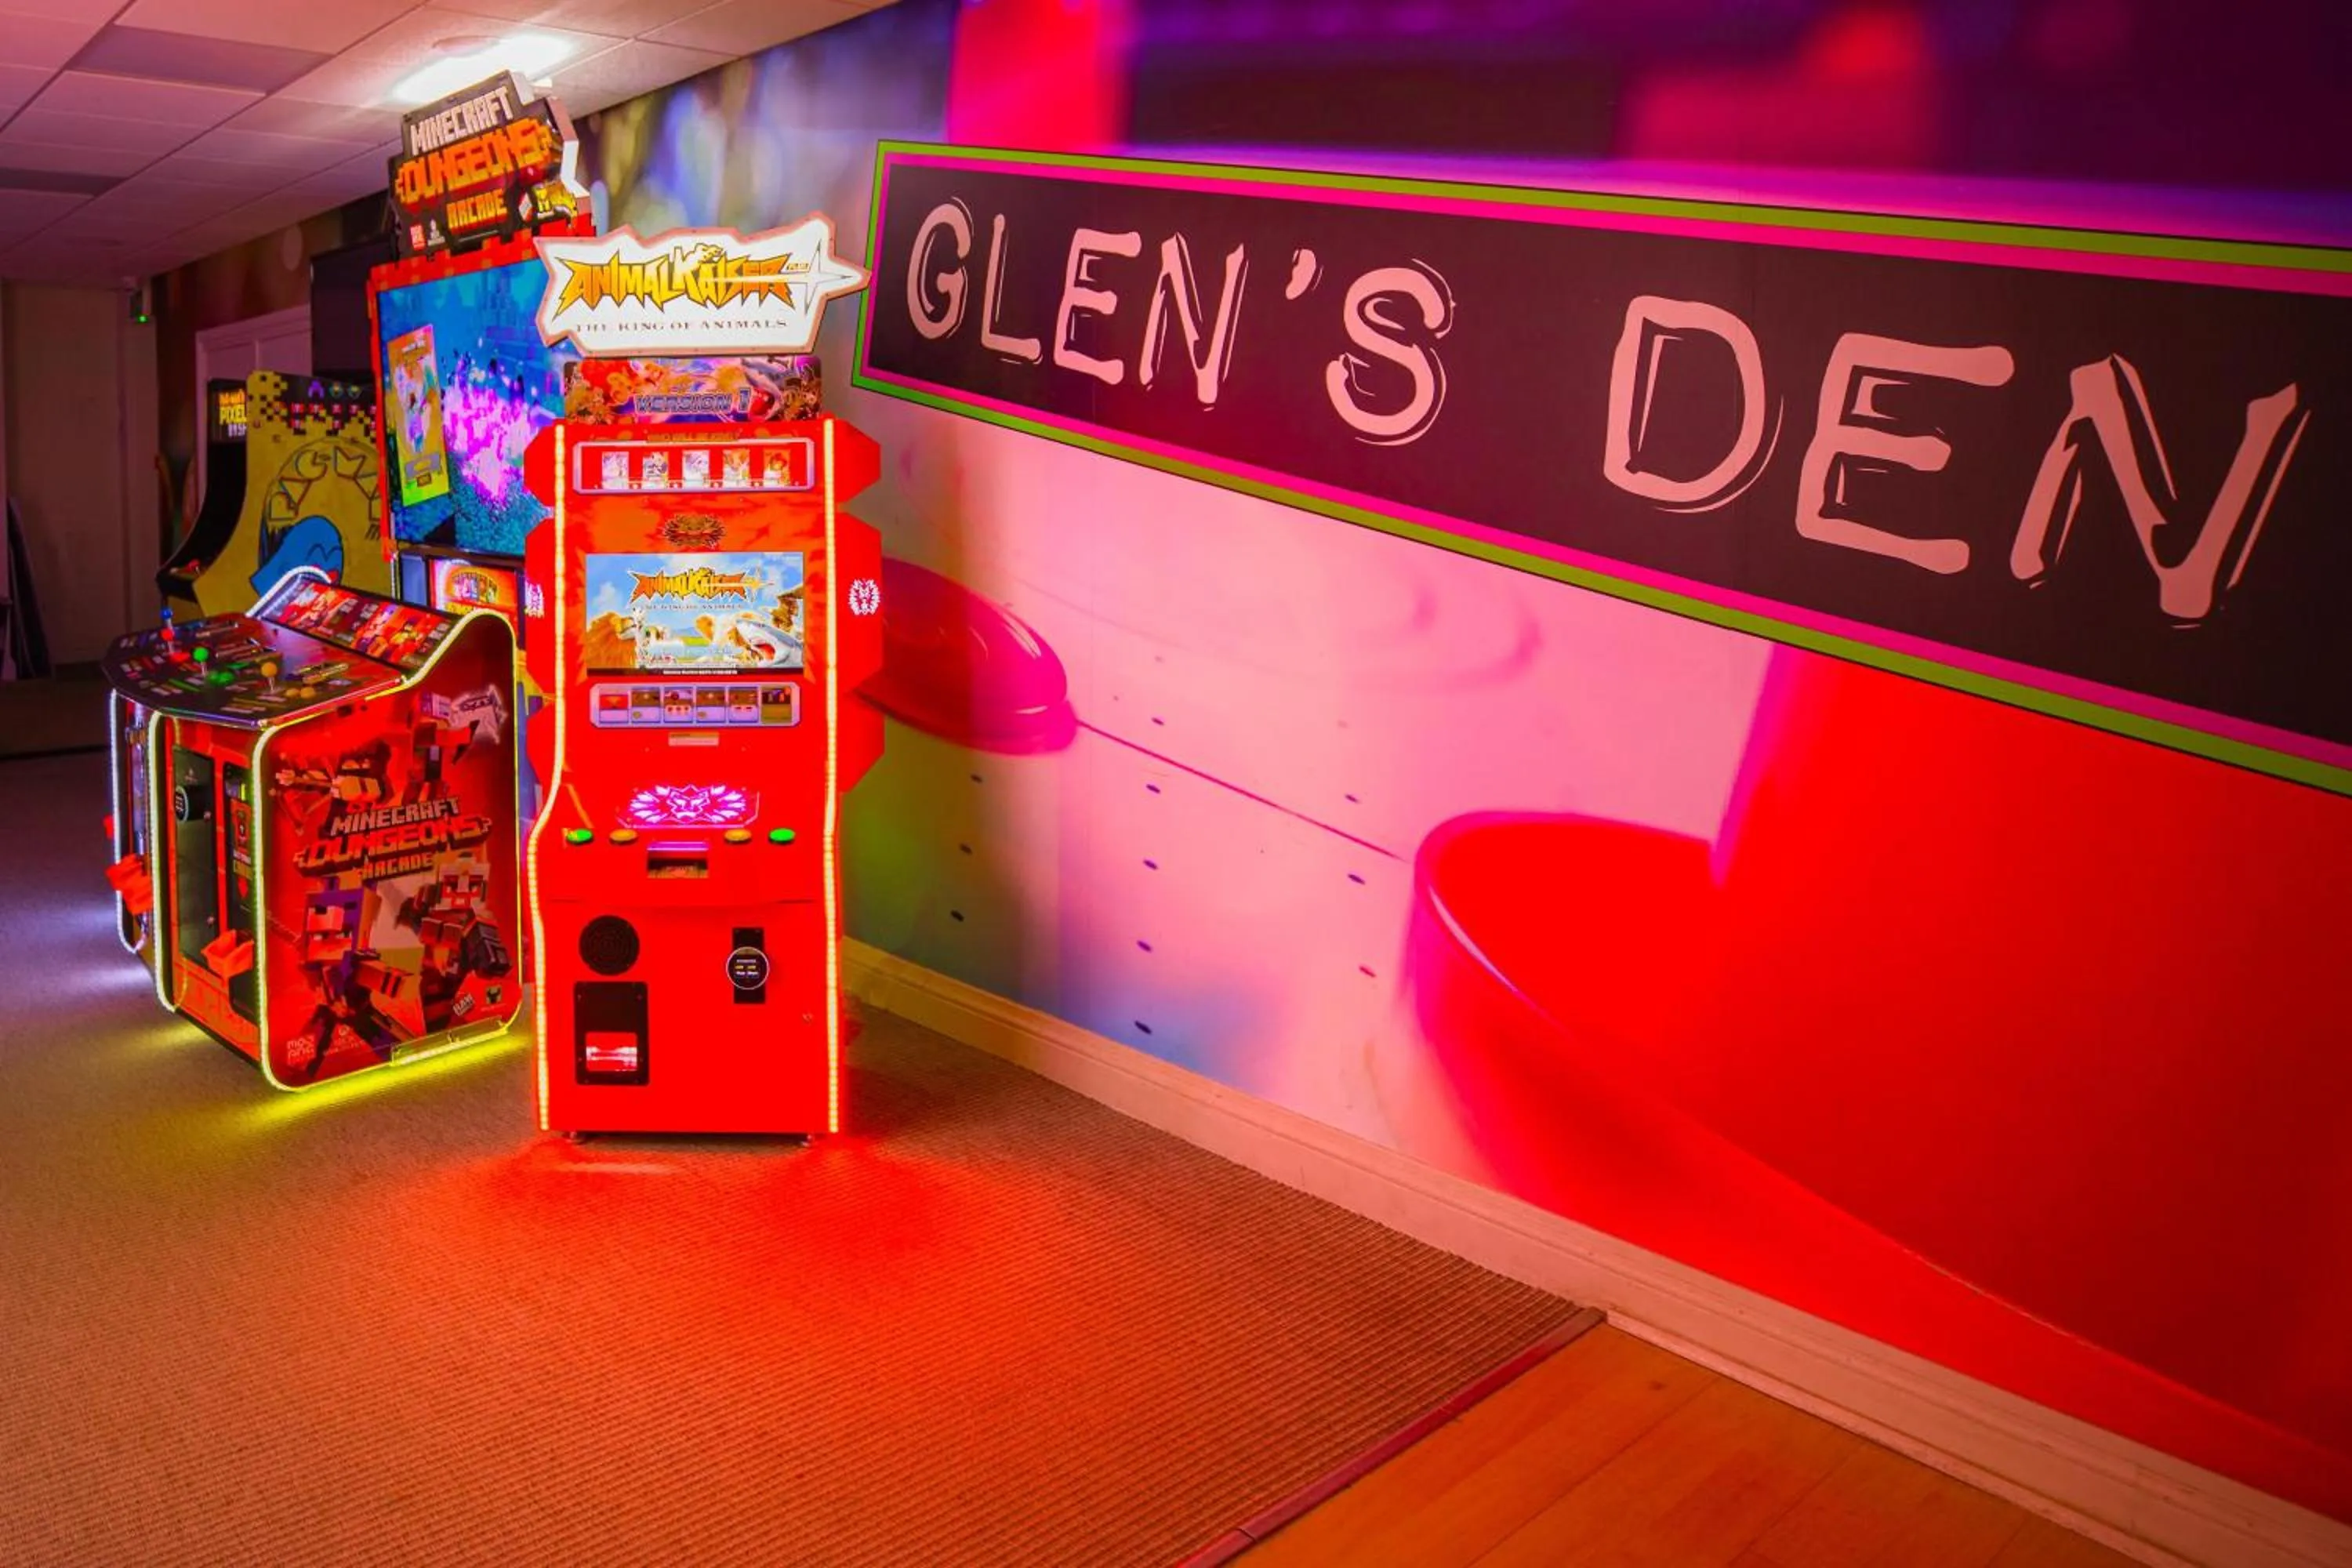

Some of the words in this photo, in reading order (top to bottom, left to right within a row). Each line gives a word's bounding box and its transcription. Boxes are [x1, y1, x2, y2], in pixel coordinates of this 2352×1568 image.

[410, 85, 514, 156] MINECRAFT
[397, 118, 551, 204] DUNGEONS
[446, 189, 508, 229] ARCADE
[618, 322, 665, 332] KING
[670, 321, 691, 330] OF
[700, 319, 789, 329] ANIMALS
[635, 392, 733, 414] VERSION
[906, 198, 1456, 447] GLEN'S
[1603, 295, 2310, 628] DEN
[330, 797, 460, 837] MINECRAFT
[295, 815, 492, 868] DUNGEONS
[361, 853, 434, 879] ARCADE
